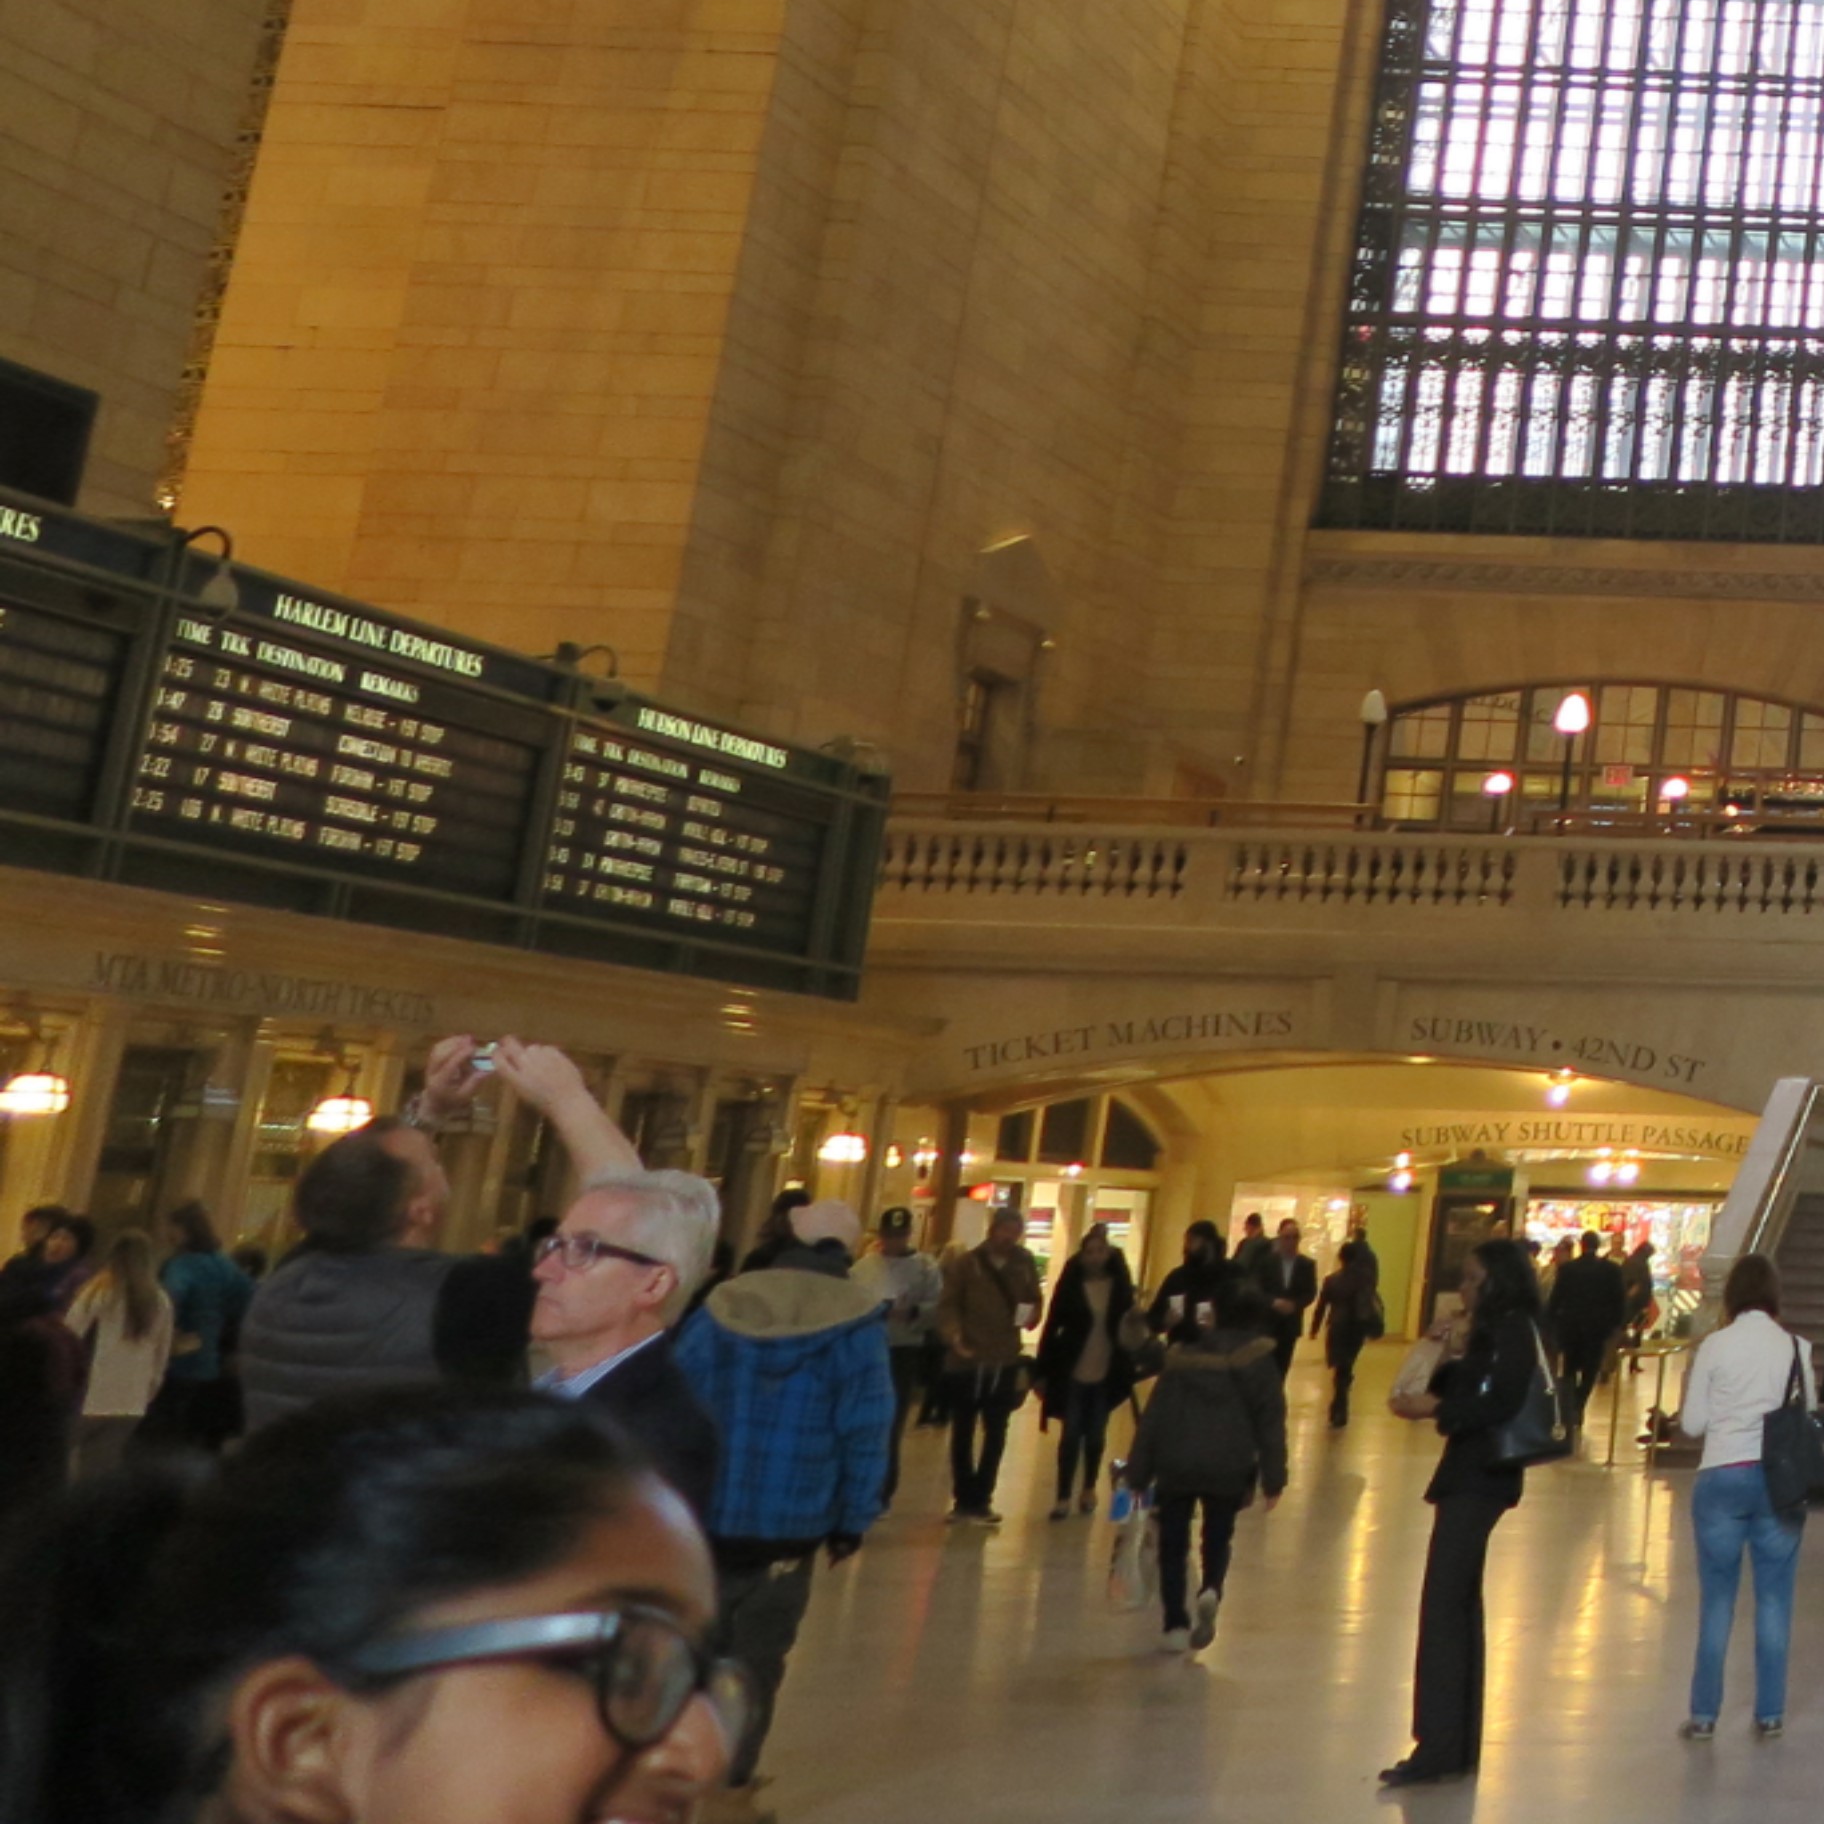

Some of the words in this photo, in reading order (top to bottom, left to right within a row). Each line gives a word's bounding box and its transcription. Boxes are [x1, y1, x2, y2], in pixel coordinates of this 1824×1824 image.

[0, 505, 42, 543] RES
[176, 618, 213, 645] TIME
[221, 630, 252, 656] TRK
[256, 640, 347, 683] DESTINATION
[360, 671, 420, 704] REMARKS
[274, 593, 350, 638] HARLEM
[349, 617, 390, 649] LINE
[389, 629, 484, 677] DEPARTURES
[638, 706, 692, 742] HUDSON
[690, 722, 721, 750] LINE
[720, 731, 788, 769] DEPARTURES
[963, 1024, 1096, 1071] TICKET
[1106, 1009, 1295, 1049] MACHINES
[1410, 1016, 1548, 1054] SUBWAY
[1572, 1035, 1657, 1073] 42ND
[1663, 1054, 1706, 1084] ST
[1401, 1120, 1512, 1148] SUBWAY
[1517, 1120, 1637, 1145] SHUTTLE
[1641, 1125, 1750, 1156] PASSAGE
